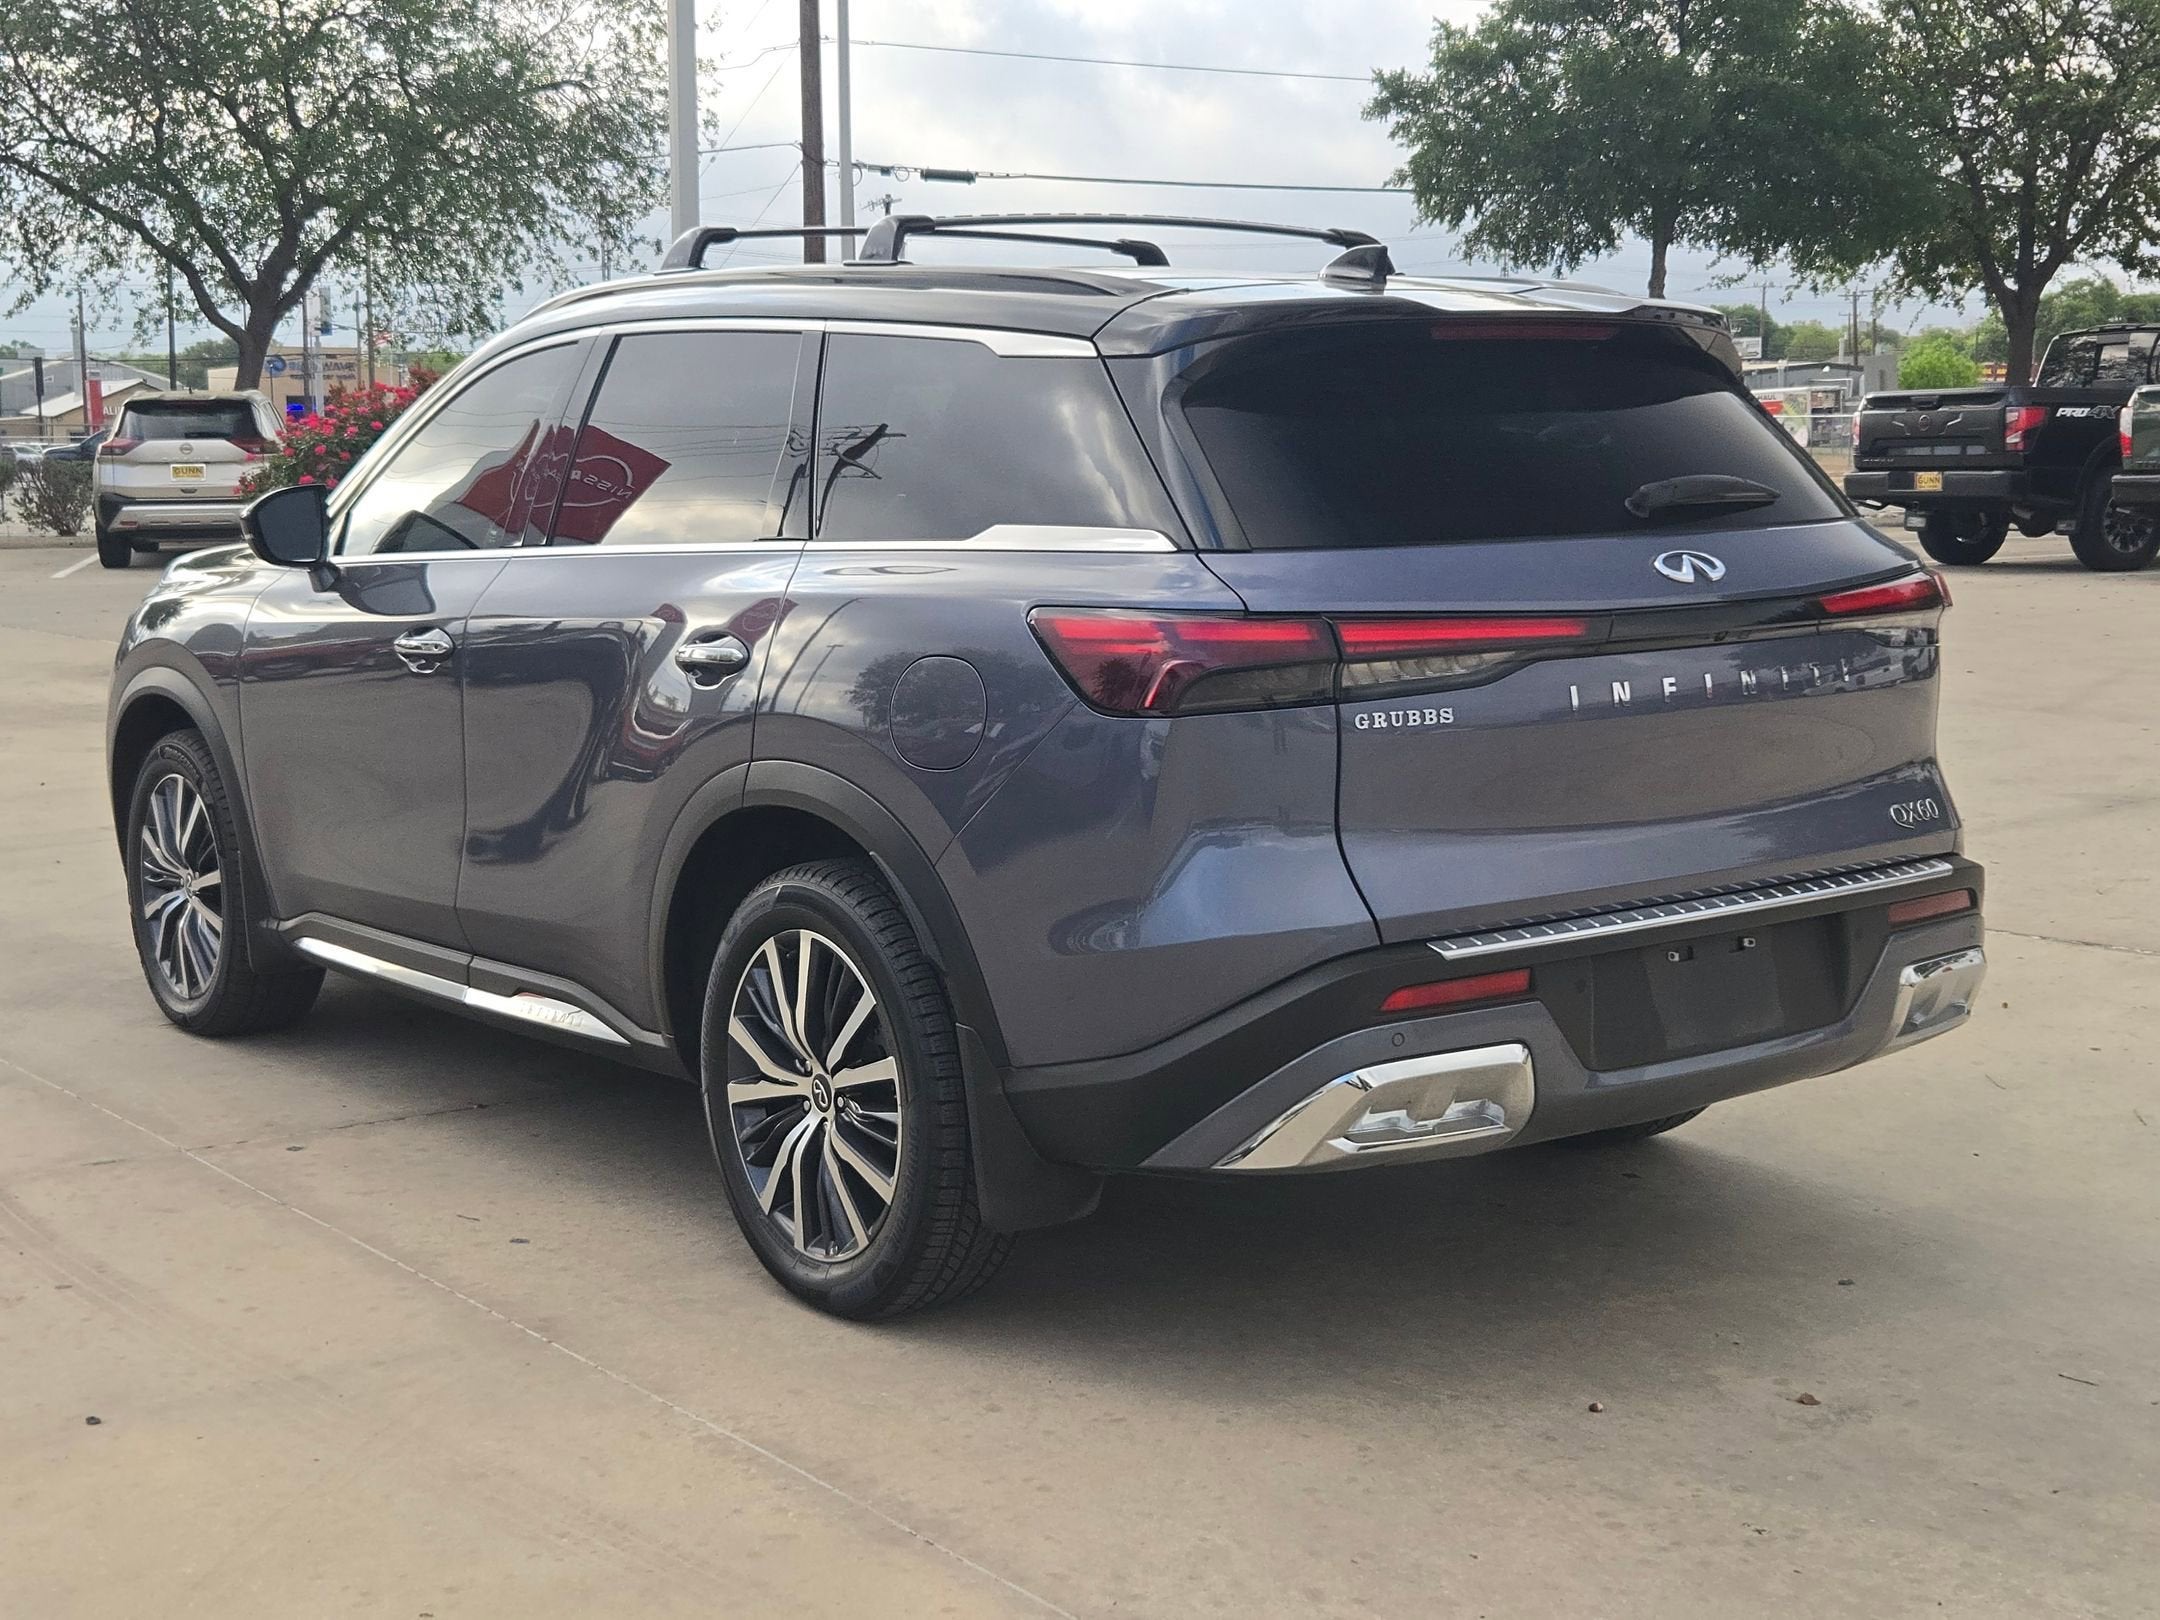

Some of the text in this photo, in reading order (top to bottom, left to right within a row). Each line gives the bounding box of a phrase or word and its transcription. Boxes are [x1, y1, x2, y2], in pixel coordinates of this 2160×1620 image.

[1917, 475, 1940, 485] GUNN
[1568, 658, 1850, 712] INFINITI
[1354, 708, 1454, 730] GRUBBS
[1889, 798, 1939, 829] QX60
